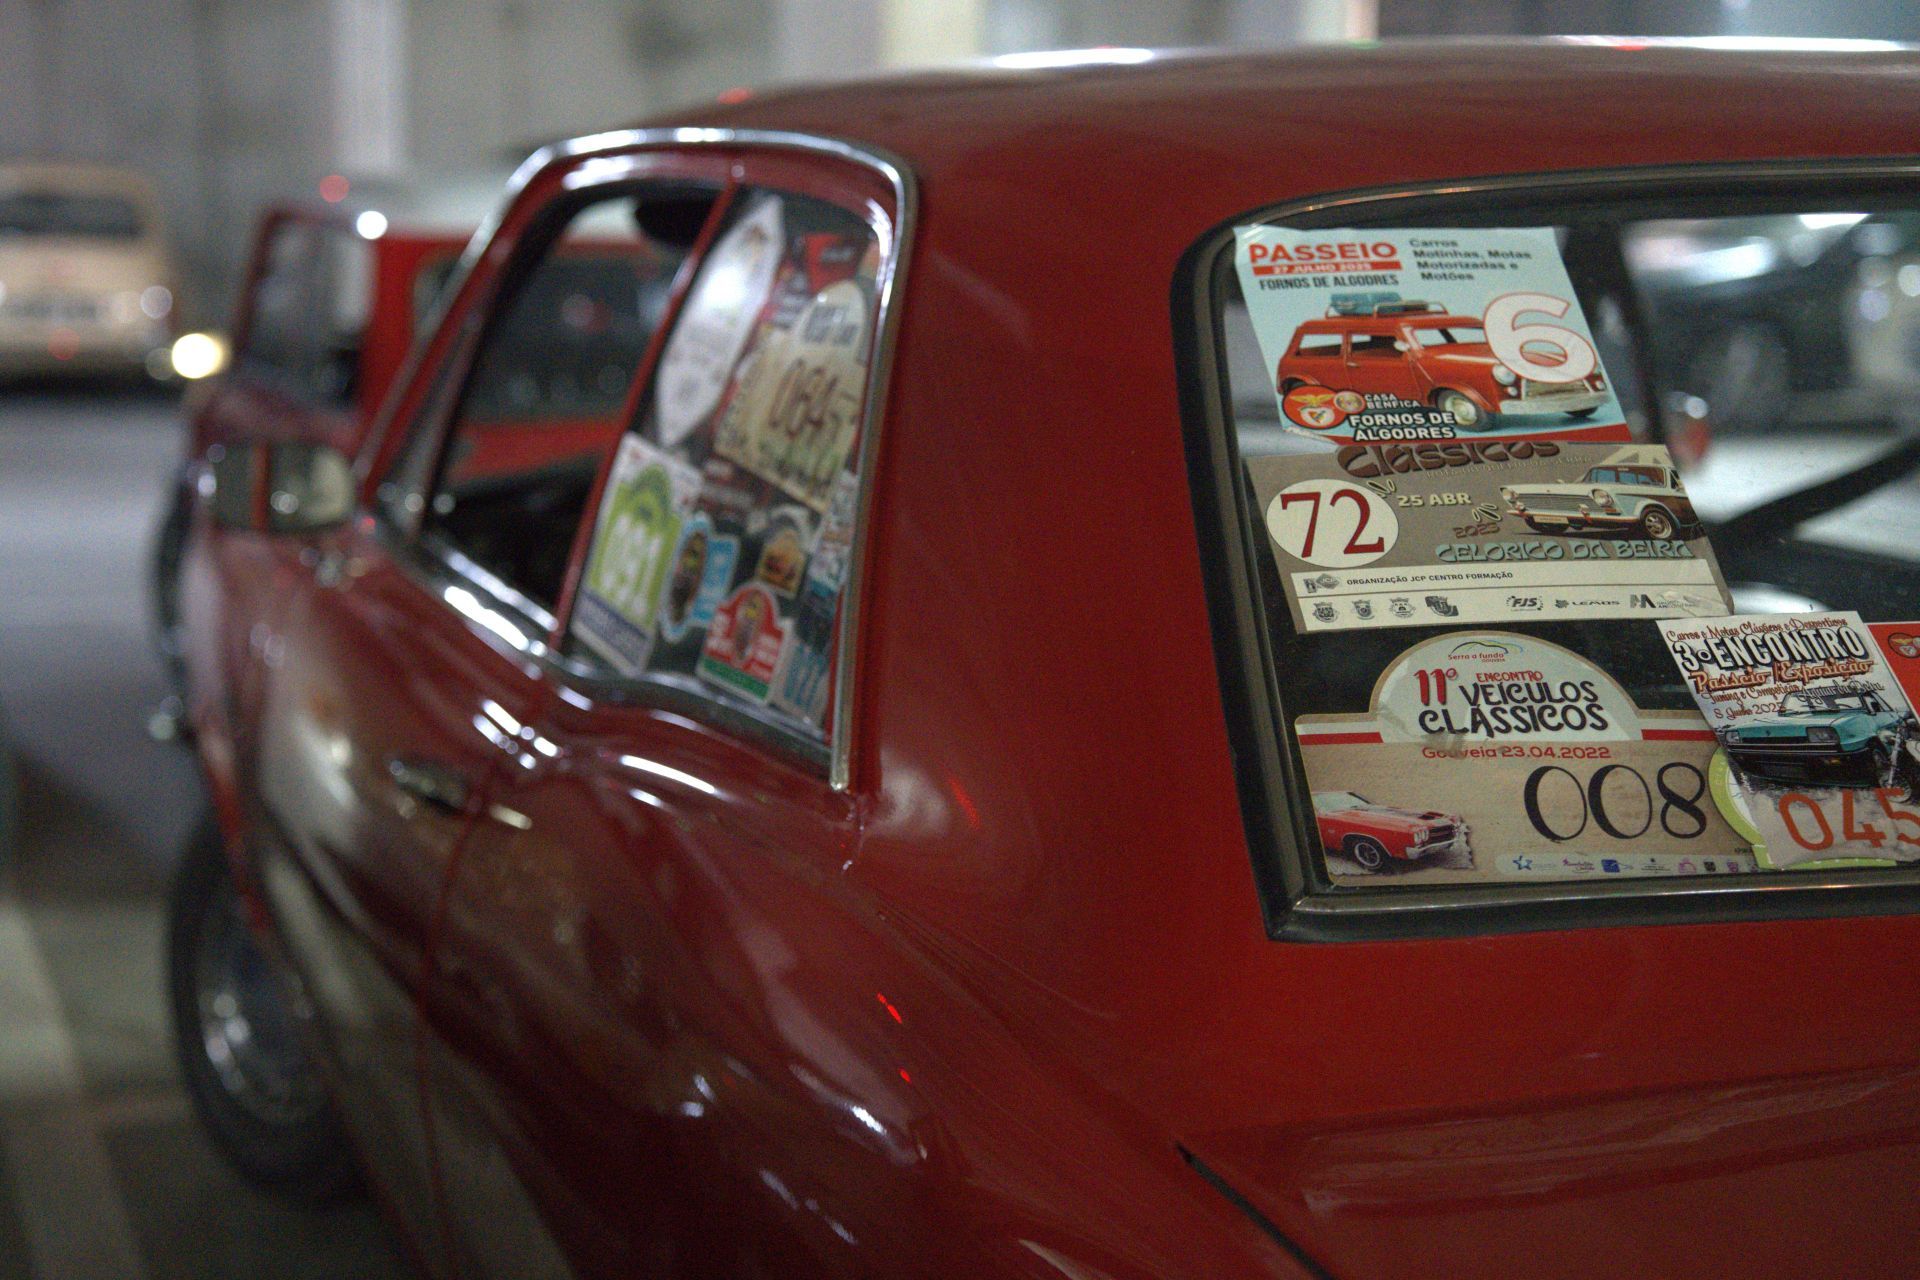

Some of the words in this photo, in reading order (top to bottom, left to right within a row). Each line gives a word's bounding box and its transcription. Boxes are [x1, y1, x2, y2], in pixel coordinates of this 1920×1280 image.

[1409, 238, 1459, 248] Carros
[1249, 242, 1397, 264] PASSEIO
[1412, 249, 1484, 260] Motinhas,
[1487, 249, 1532, 259] Motas
[1293, 262, 1336, 274] JULHO
[1416, 260, 1506, 270] Motorizadas
[1509, 262, 1519, 270] e
[1259, 278, 1311, 291] FORNOS
[1313, 276, 1331, 288] DE
[1334, 274, 1399, 287] ALGODRES
[1482, 291, 1597, 384] 6
[1364, 393, 1399, 402] CASA
[1366, 400, 1422, 410] BENFICA
[1350, 412, 1426, 428] FORNOS
[1429, 412, 1455, 425] DE
[1354, 426, 1455, 442] ALGODRES
[1398, 495, 1424, 507] 25
[1429, 493, 1473, 506] ABR
[1280, 488, 1385, 559] 72
[1435, 540, 1566, 563] CELORICO
[1568, 541, 1610, 561] DA
[1615, 539, 1697, 560] BEIRA
[1346, 575, 1408, 586] ORGANIZAÇÃO
[1410, 573, 1427, 582] JCP
[1429, 572, 1464, 581] CENTRO
[1466, 570, 1513, 581] FORMAÇÃO
[1511, 596, 1538, 608] FJS
[1666, 629, 1701, 643] Carros
[1706, 624, 1739, 640] Motas
[1708, 626, 1869, 671] ENCONTRO
[1475, 670, 1544, 683] ENCONTRO
[1418, 703, 1609, 739] CLÁSSICOS
[1501, 745, 1612, 760] 23.04.2022
[1523, 762, 1706, 842] 008
[1778, 786, 1920, 851] 045
